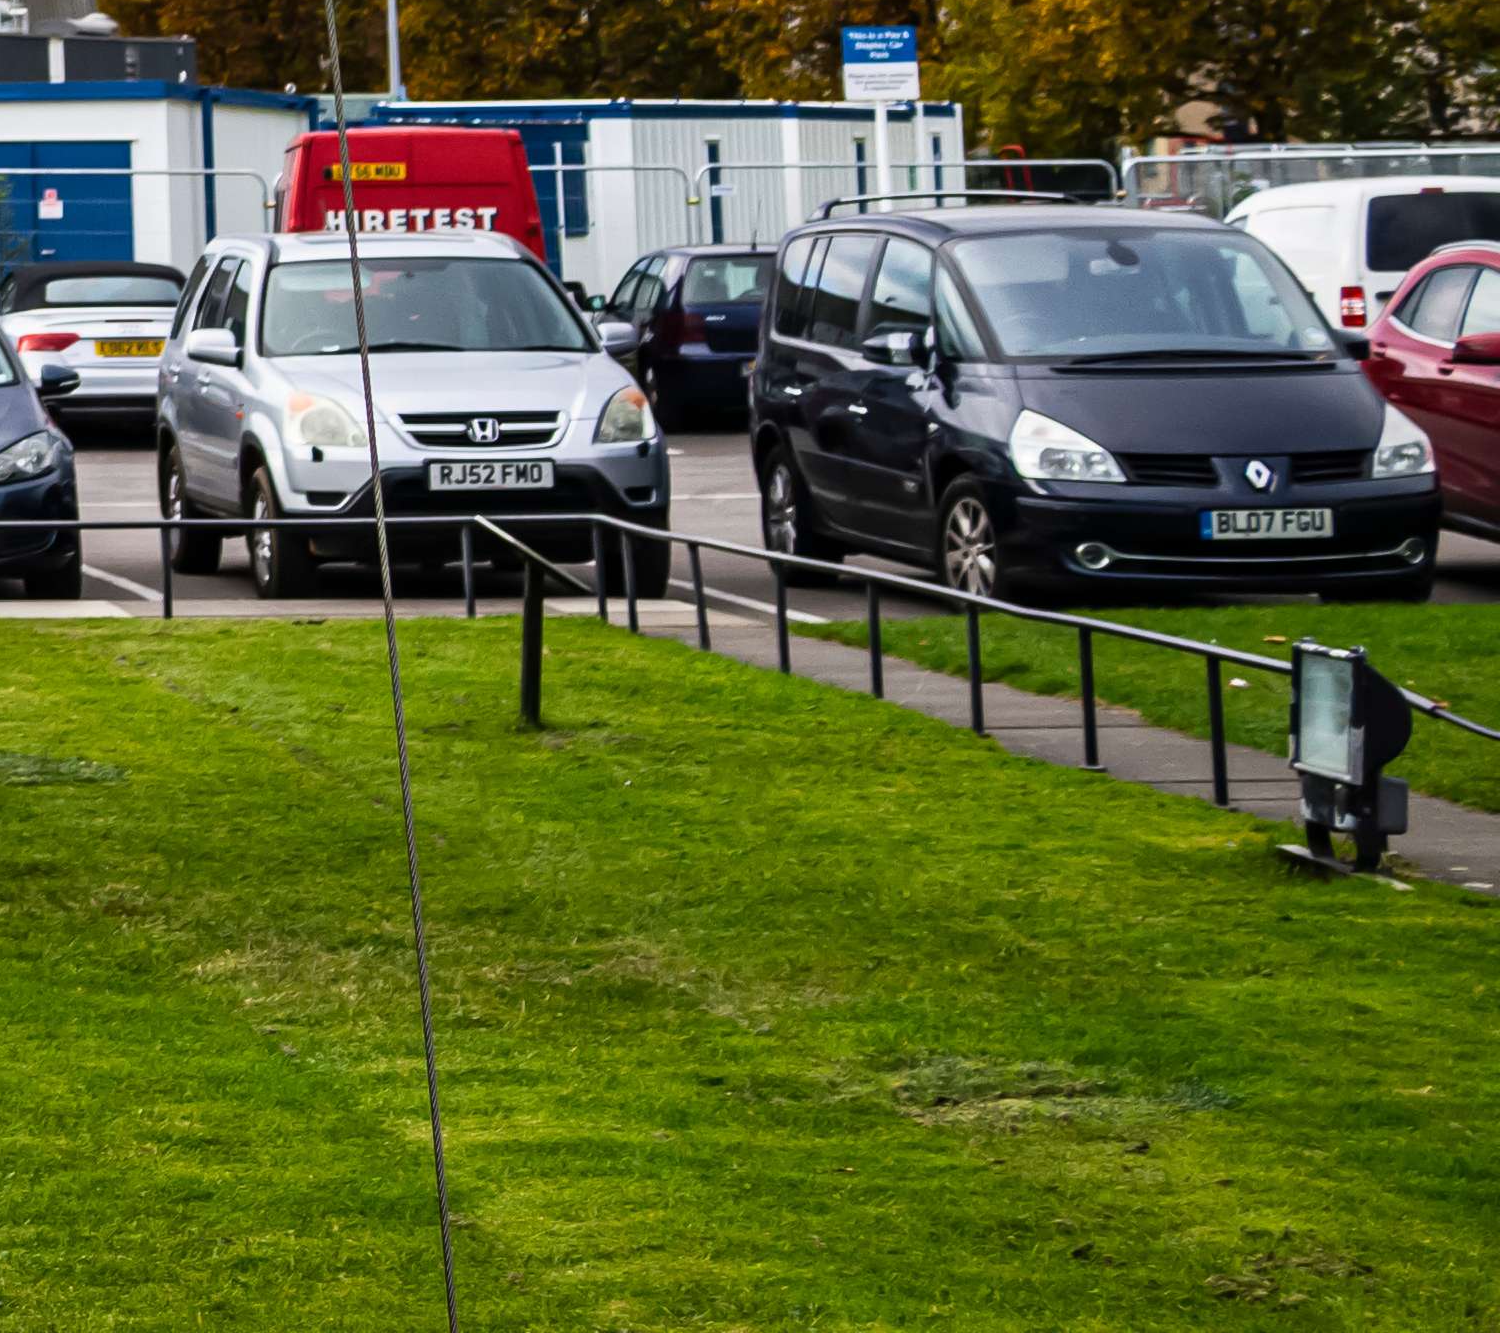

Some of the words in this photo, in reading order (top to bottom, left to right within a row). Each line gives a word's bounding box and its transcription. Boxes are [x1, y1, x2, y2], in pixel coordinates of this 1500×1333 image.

[440, 465, 496, 485] RJ52
[1216, 512, 1275, 534] BL07
[1281, 511, 1325, 532] FGU
